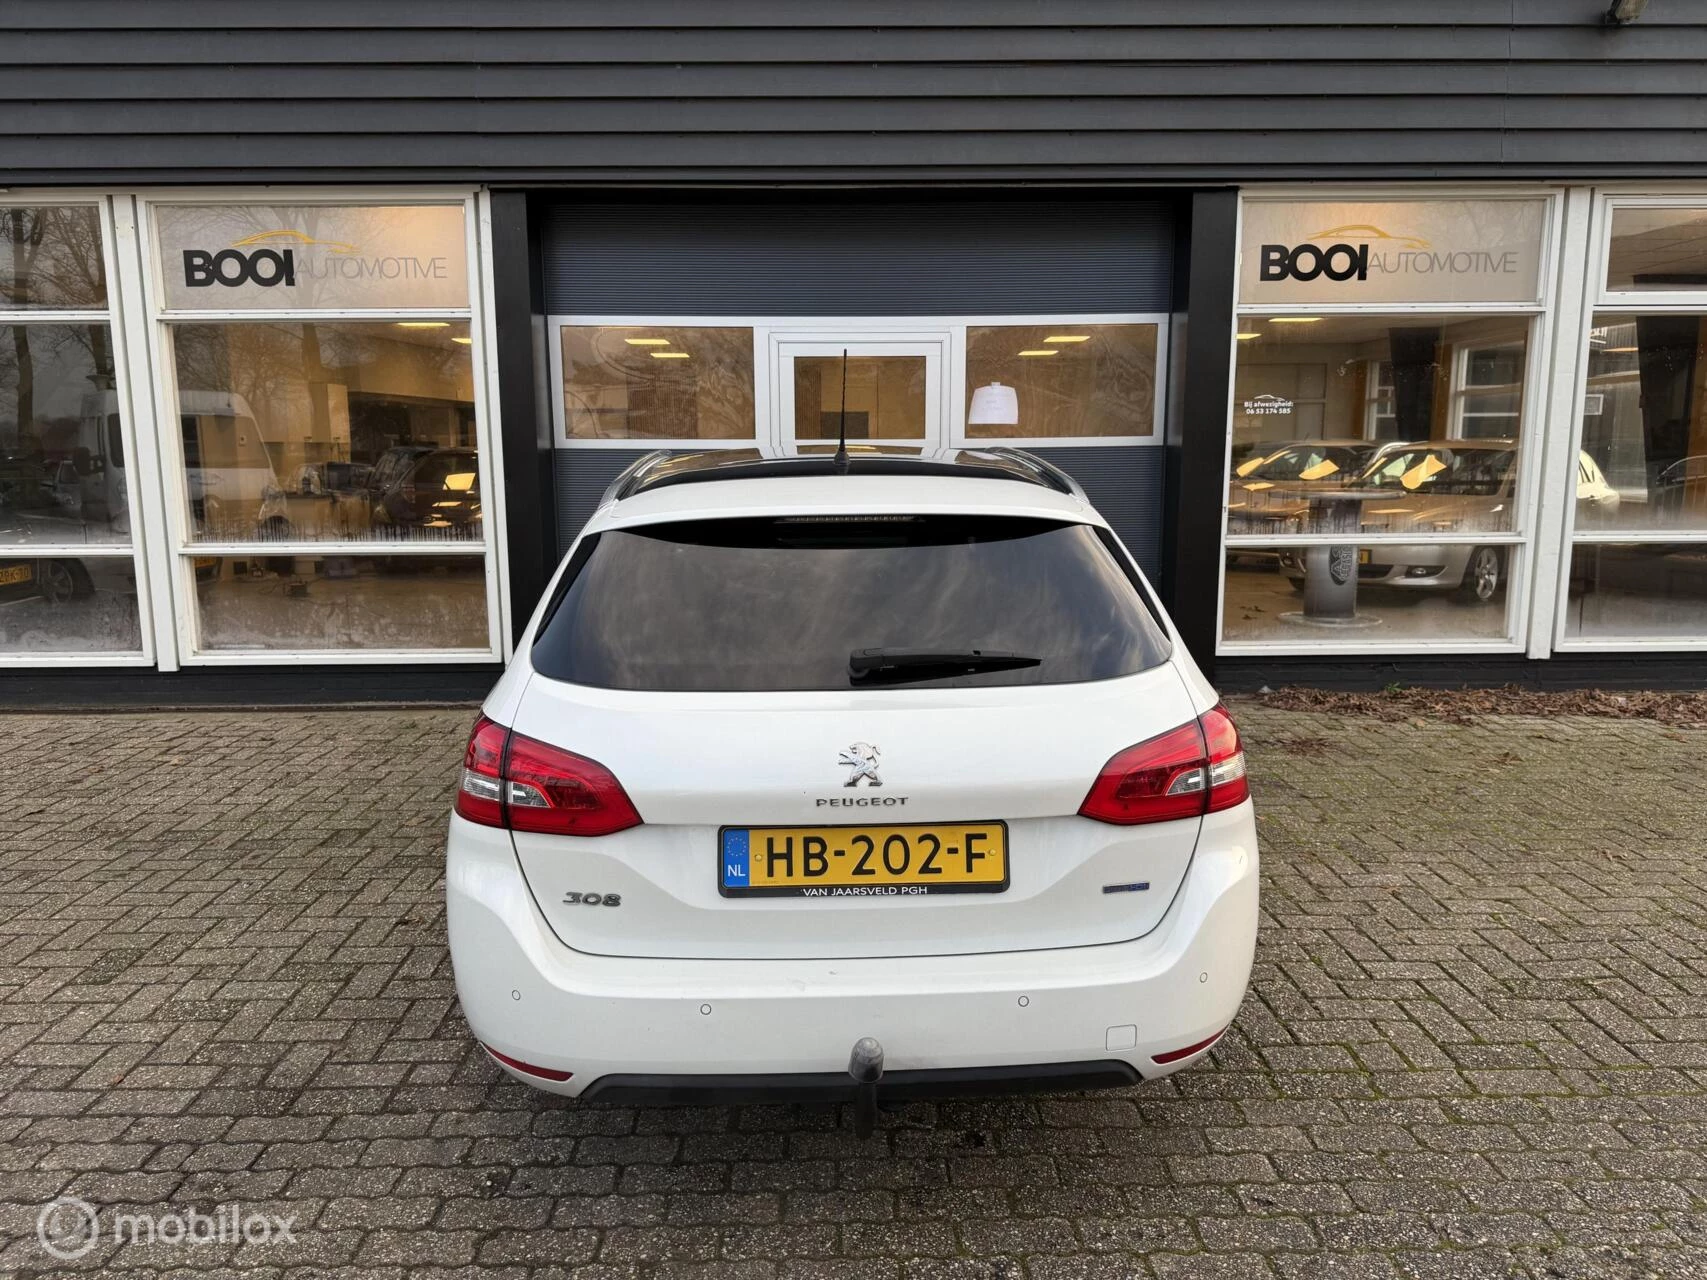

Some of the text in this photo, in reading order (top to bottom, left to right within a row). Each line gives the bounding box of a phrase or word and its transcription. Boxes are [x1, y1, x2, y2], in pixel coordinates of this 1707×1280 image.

[183, 248, 448, 287] BOOI AUTOMOTIVE
[1259, 243, 1517, 282] BOOI AUTOMOTIVE
[816, 797, 909, 807] PEUGEOT
[766, 833, 988, 878] HB-202-F
[727, 865, 746, 877] NL
[562, 891, 621, 907] 308
[802, 886, 928, 896] VAN JAARSVELD PGH
